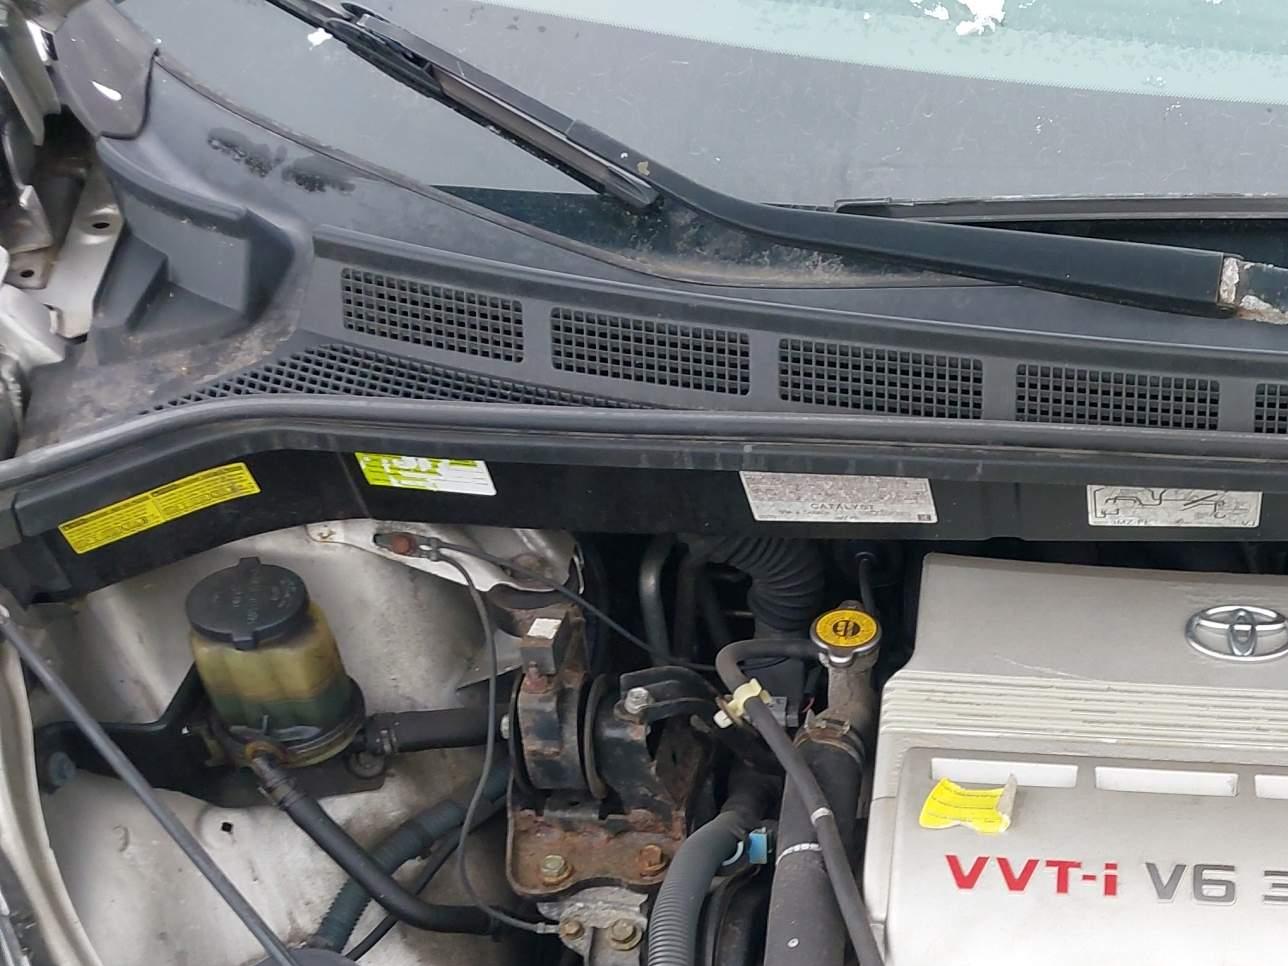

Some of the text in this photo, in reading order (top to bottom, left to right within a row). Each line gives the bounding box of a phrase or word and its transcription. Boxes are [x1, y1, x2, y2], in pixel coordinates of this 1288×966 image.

[810, 502, 874, 511] CATALYST
[945, 854, 1119, 897] VVT-i
[1145, 862, 1237, 904] V6
